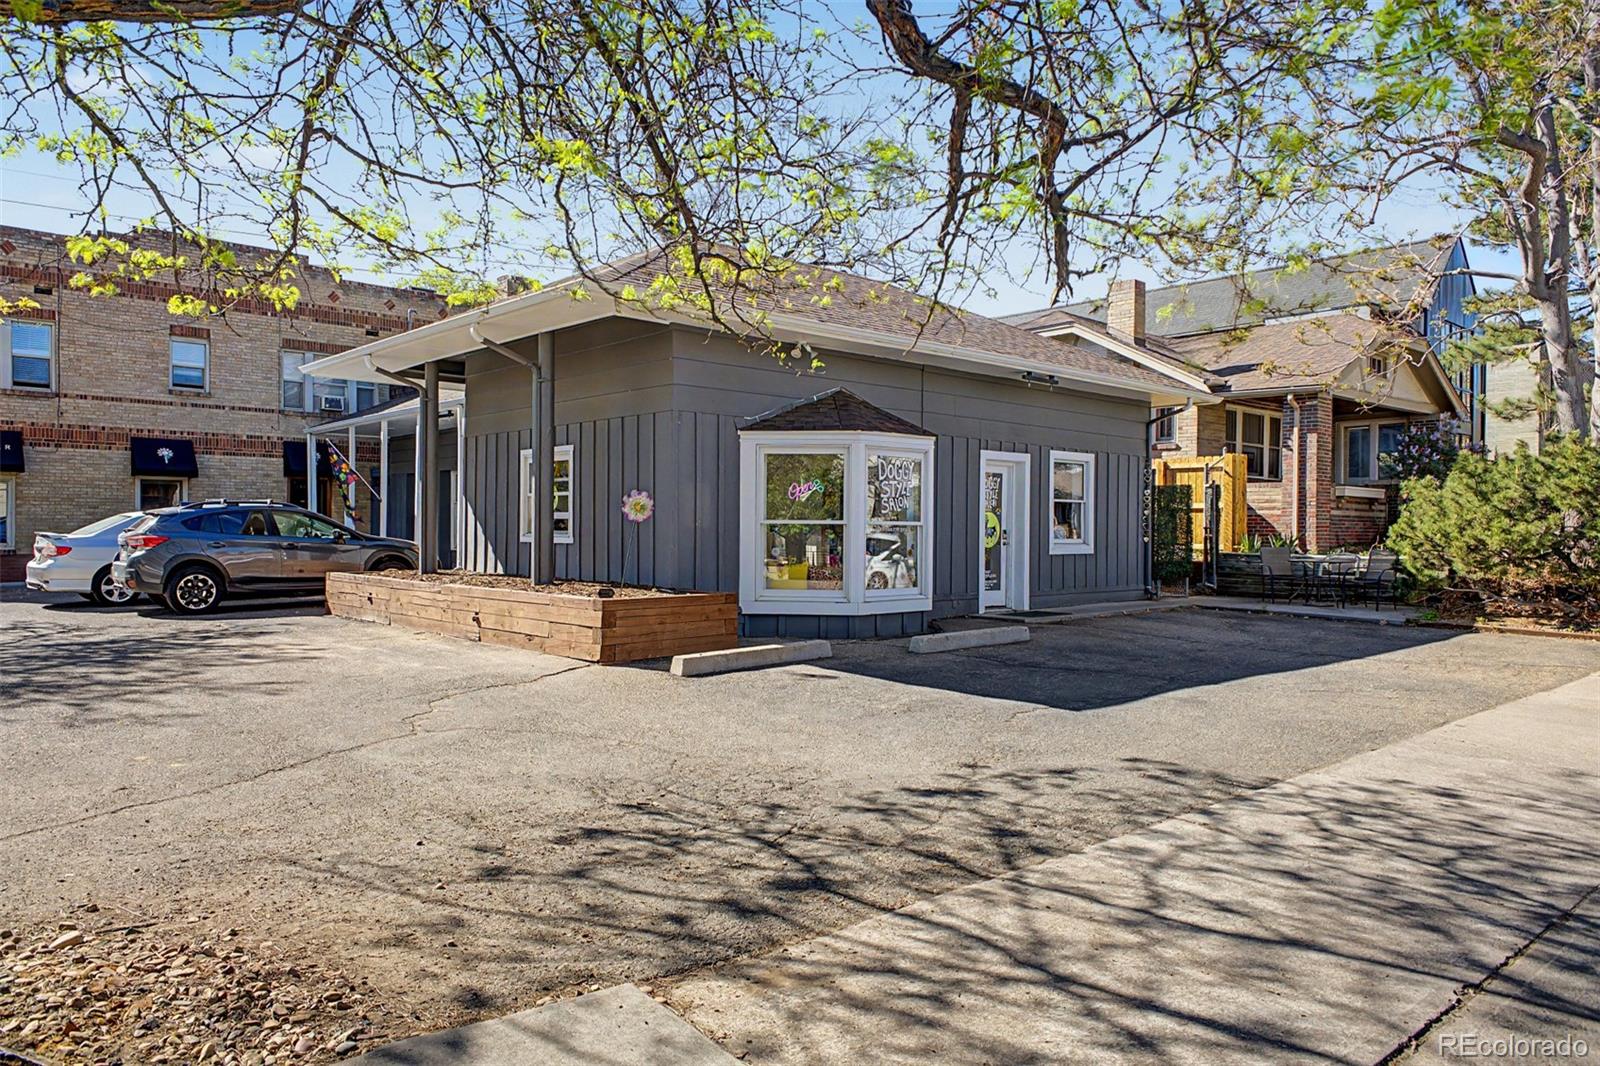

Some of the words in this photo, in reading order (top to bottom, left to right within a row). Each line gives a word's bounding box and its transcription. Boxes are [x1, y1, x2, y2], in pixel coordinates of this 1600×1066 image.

[878, 458, 915, 482] DOGGY
[788, 481, 814, 502] Open
[880, 480, 914, 498] STYLE
[881, 495, 909, 514] SALON
